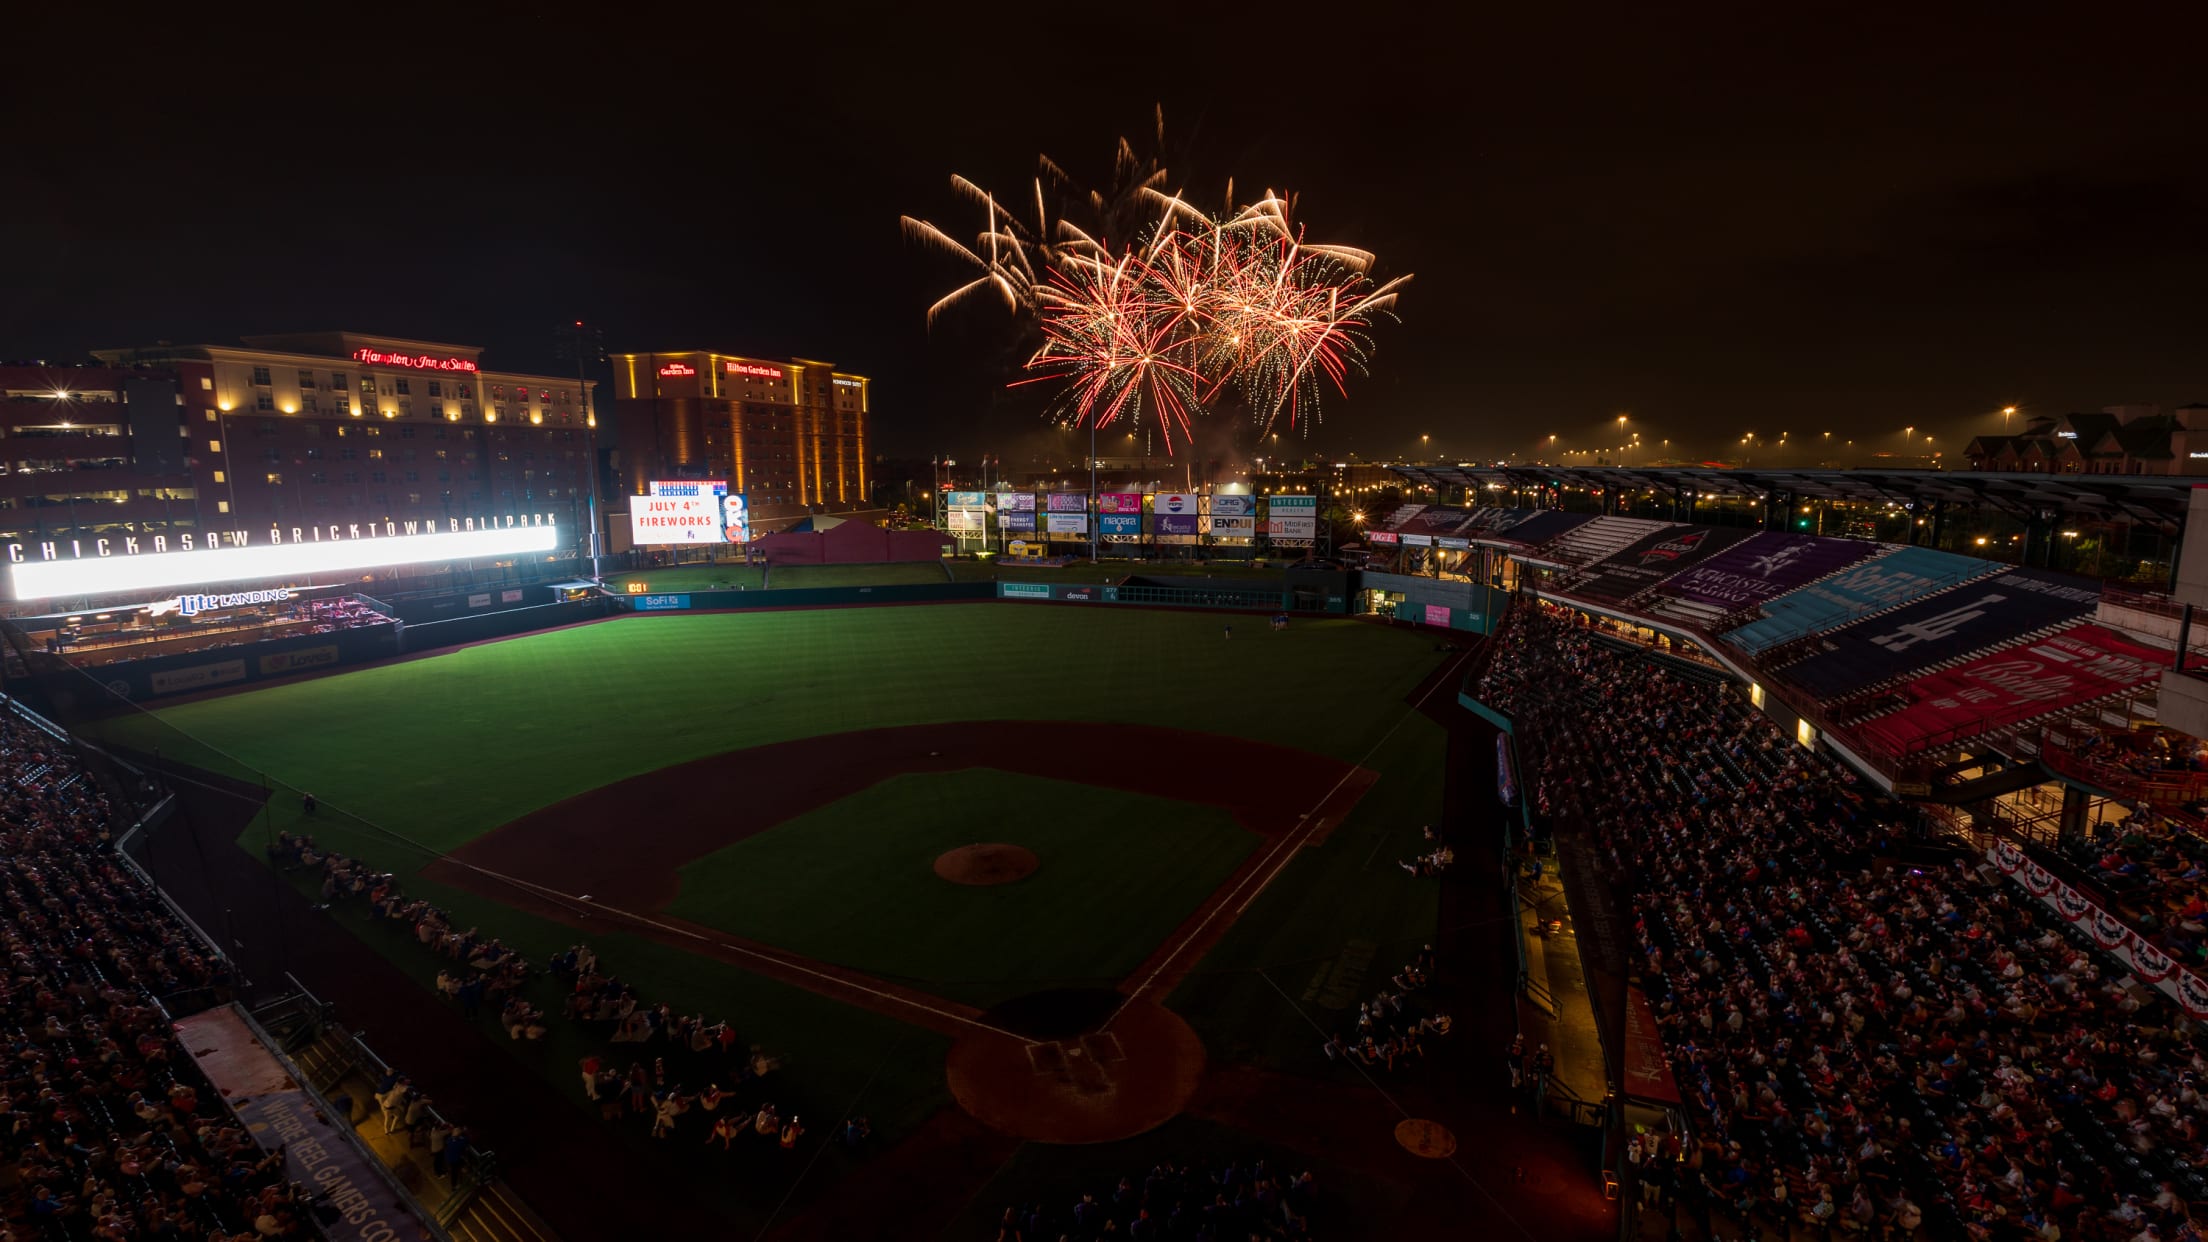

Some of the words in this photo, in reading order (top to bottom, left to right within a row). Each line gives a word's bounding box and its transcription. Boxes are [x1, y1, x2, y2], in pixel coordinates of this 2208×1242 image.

[360, 348, 414, 367] Hampton
[414, 356, 441, 369] Inn
[448, 358, 476, 371] Suites
[683, 367, 694, 375] Inn
[726, 362, 748, 374] Hilton
[749, 365, 770, 376] Garden
[771, 369, 781, 377] Inn
[649, 501, 677, 511] JULY
[640, 516, 711, 526] FIREWORKS
[1104, 516, 1136, 527] niagara
[1215, 519, 1251, 528] ENDUI
[9, 530, 249, 563] CHICKASAW
[271, 519, 436, 545] BRICKTOWN
[450, 512, 556, 533] BALLPARK
[1689, 567, 1787, 595] NEWCASTLE
[1067, 592, 1088, 600] devon
[1681, 580, 1750, 602] CASINO
[180, 594, 219, 617] Lite
[220, 589, 289, 606] LANDING
[646, 596, 668, 605] SoFi
[262, 1101, 310, 1145] WHERE
[294, 1137, 330, 1173] REEL
[313, 1164, 377, 1225] GAMERS
[359, 1220, 401, 1242] CO
